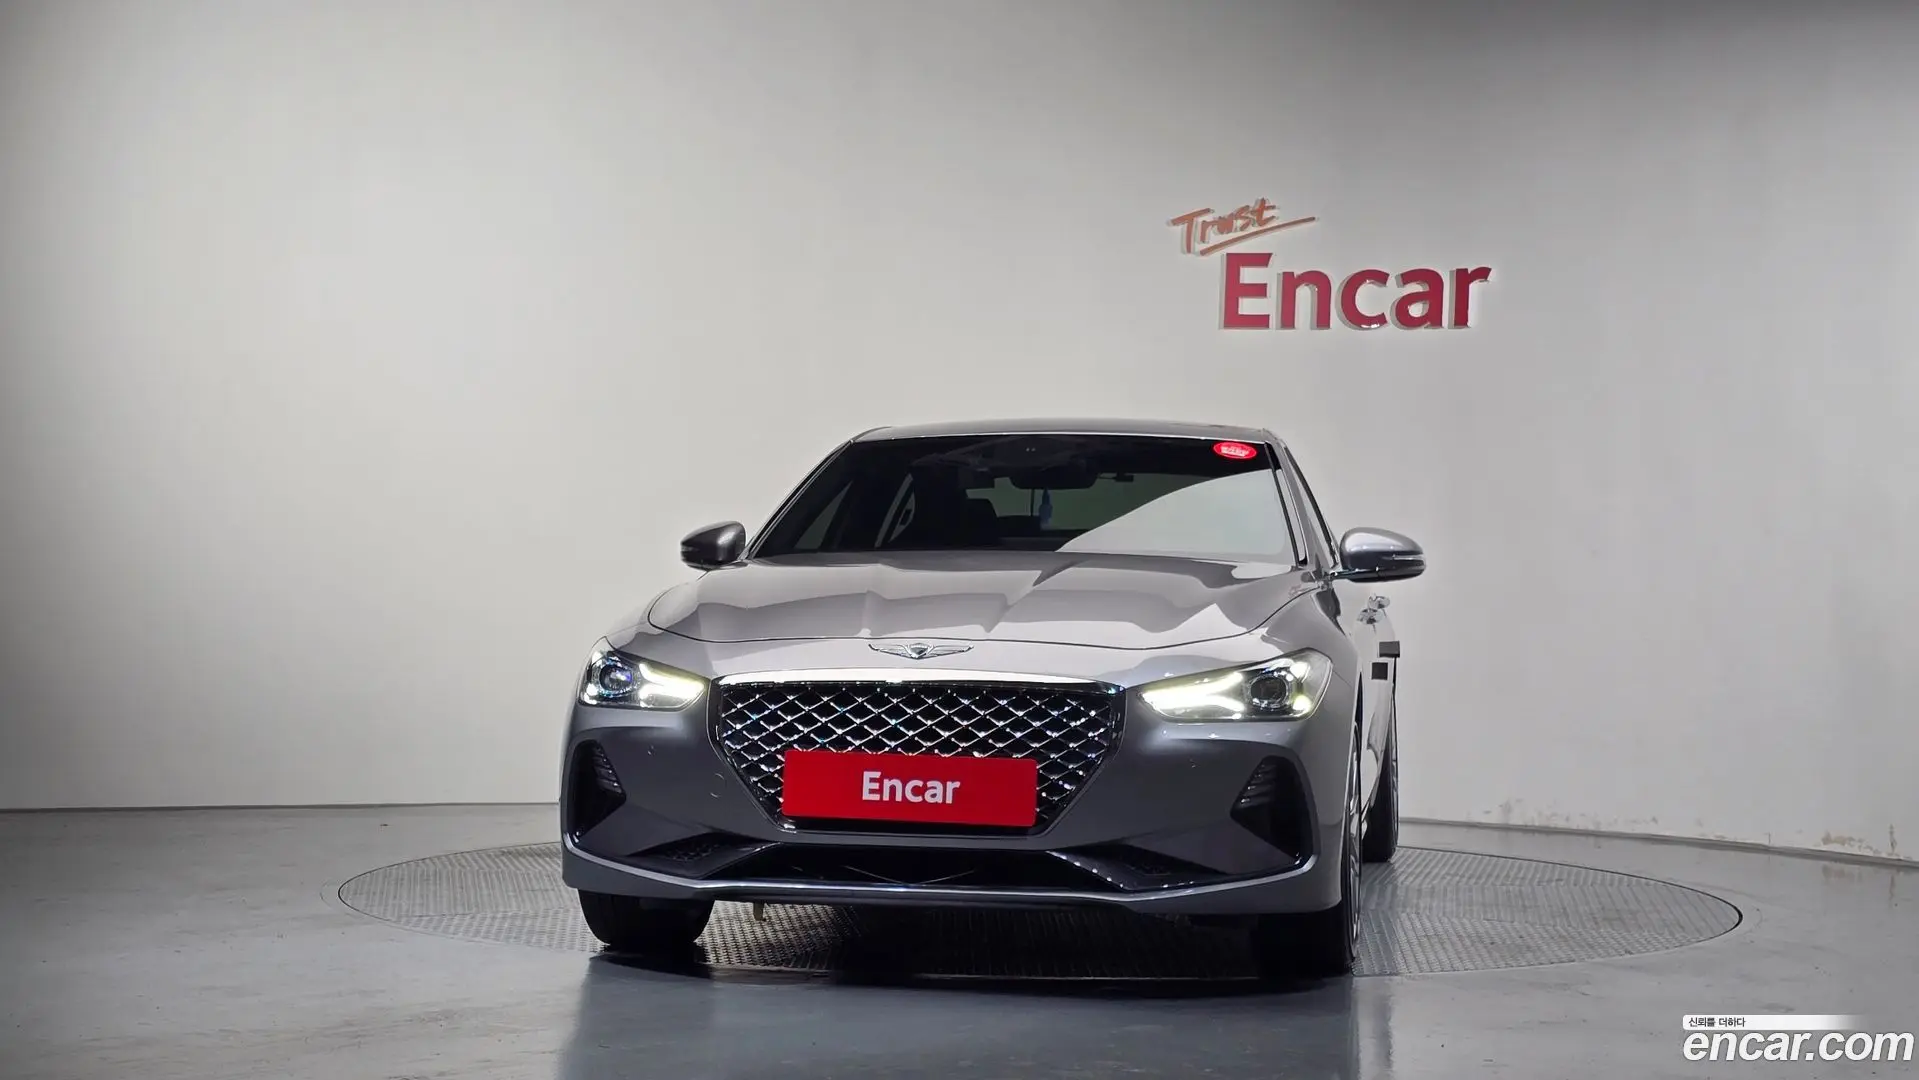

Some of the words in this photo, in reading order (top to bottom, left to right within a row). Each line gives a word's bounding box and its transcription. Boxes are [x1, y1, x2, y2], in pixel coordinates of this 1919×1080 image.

[1169, 197, 1279, 254] Trust
[1222, 252, 1492, 330] Encar
[861, 770, 961, 805] Encar
